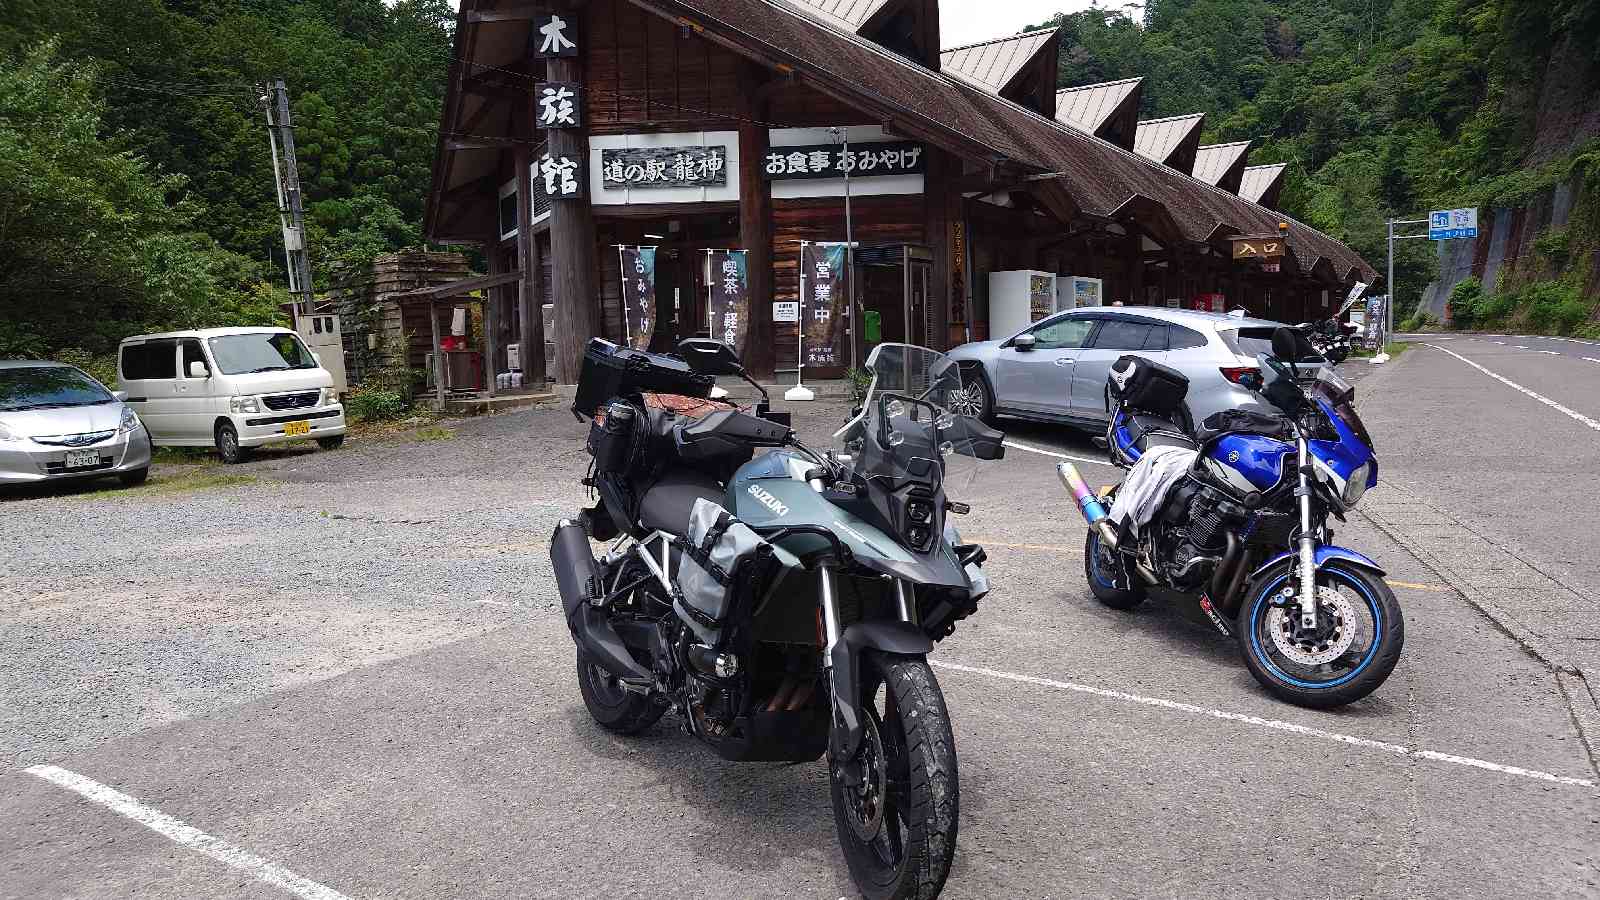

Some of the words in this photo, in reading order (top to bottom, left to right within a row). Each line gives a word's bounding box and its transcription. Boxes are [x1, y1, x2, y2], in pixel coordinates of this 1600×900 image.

[539, 15, 578, 195] 木族館
[603, 159, 668, 182] 道の駅
[672, 150, 723, 181] 龍神
[766, 150, 831, 174] お食事
[834, 145, 922, 171] おみやげ
[1239, 243, 1278, 255] 入口
[814, 261, 832, 324] 営業中
[747, 484, 790, 517] SUZUKI
